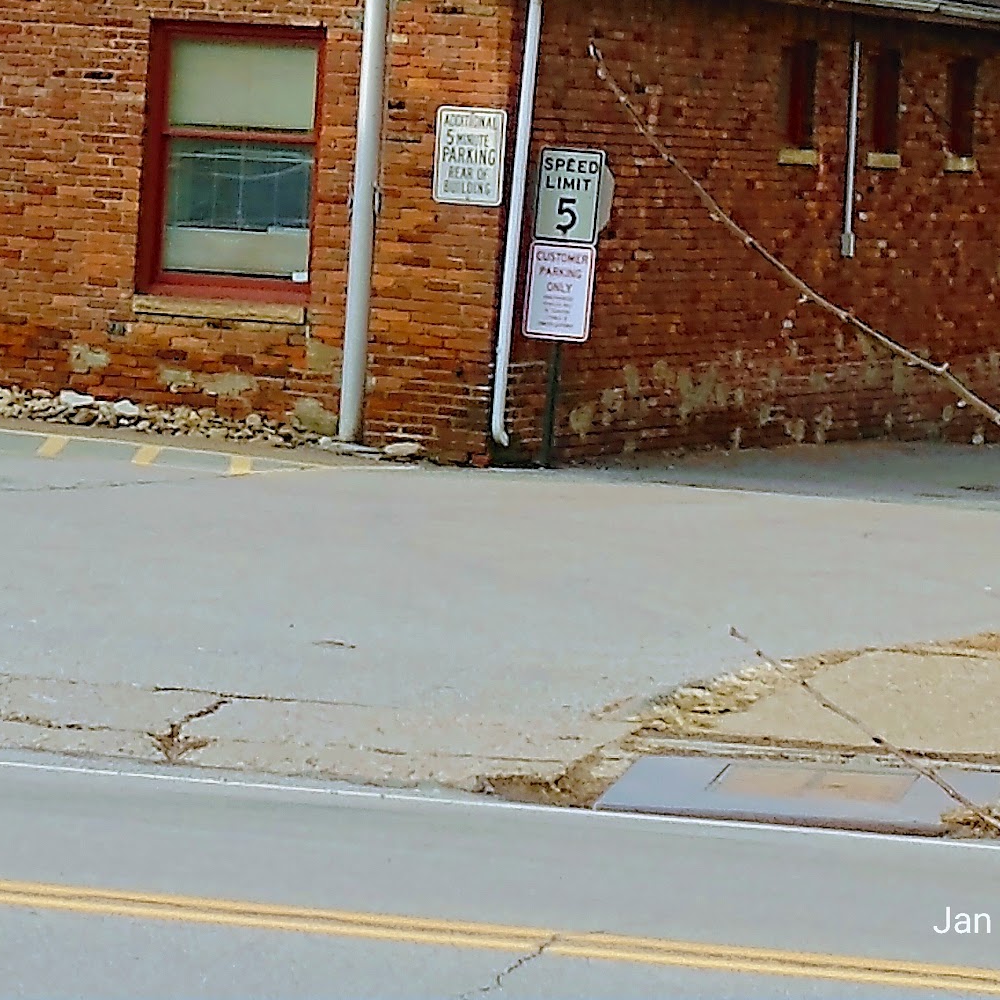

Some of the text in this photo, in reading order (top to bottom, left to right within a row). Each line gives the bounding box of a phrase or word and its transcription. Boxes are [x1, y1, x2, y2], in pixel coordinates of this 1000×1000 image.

[446, 129, 454, 145] 5
[442, 146, 496, 166] PARKING
[448, 166, 473, 179] REAR
[544, 157, 599, 174] SPEED
[443, 179, 491, 196] BLDING
[546, 176, 591, 191] LIMIT
[556, 197, 577, 234] 5
[536, 250, 588, 264] CUSTOMER
[538, 266, 582, 279] PARKING
[546, 281, 573, 293] ONLY
